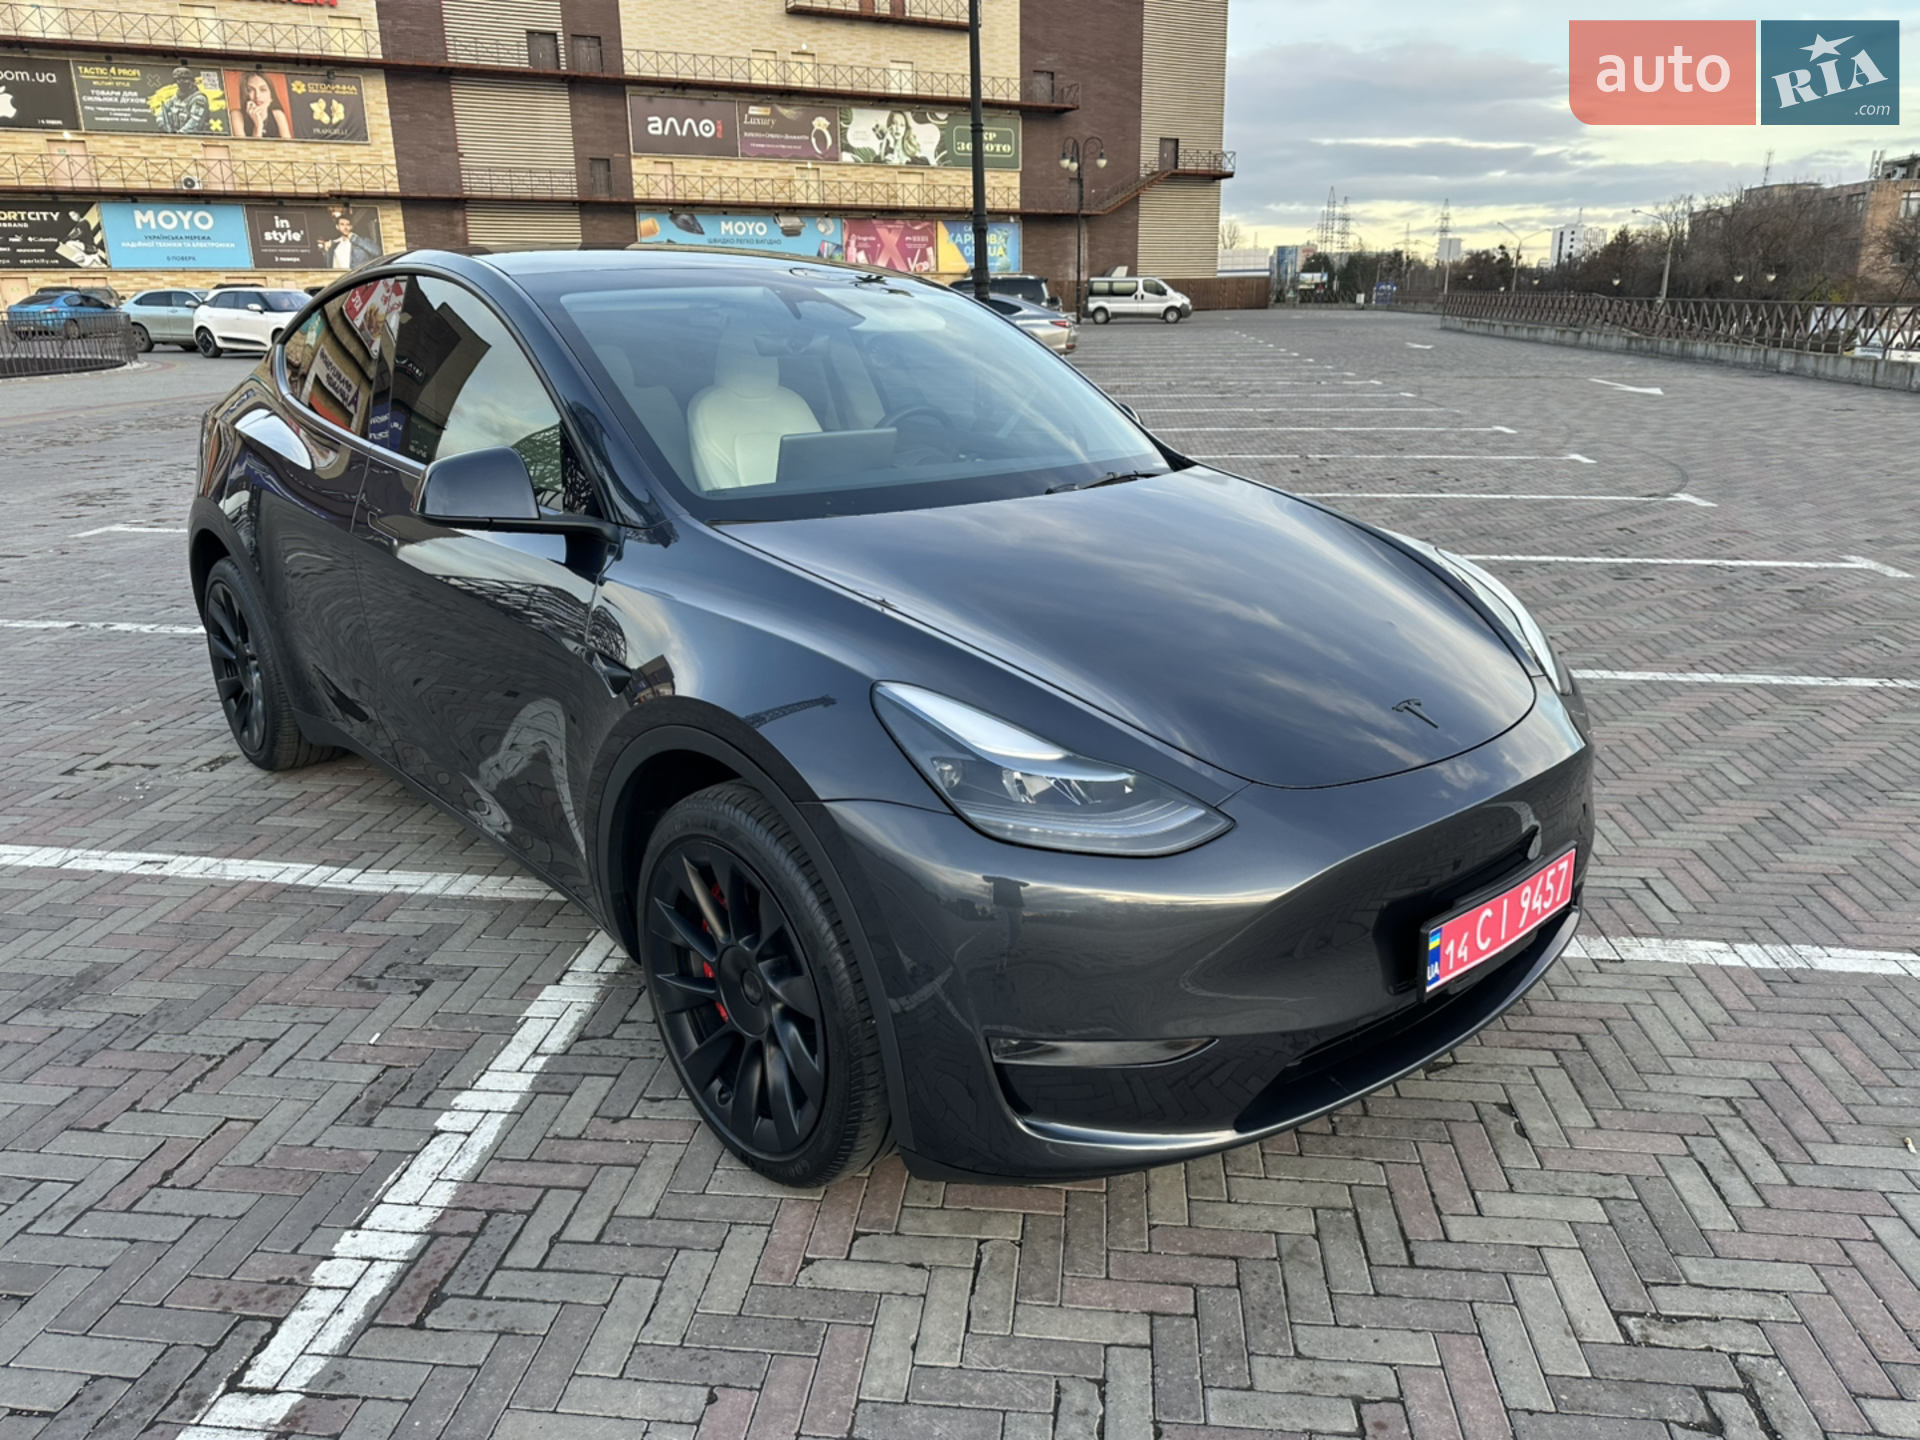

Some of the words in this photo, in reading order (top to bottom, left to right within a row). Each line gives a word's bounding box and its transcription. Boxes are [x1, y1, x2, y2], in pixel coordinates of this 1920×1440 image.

[743, 114, 777, 129] Luxury
[956, 142, 1012, 154] ЗООТО
[133, 210, 214, 230] MOYO
[274, 215, 290, 228] in
[721, 221, 768, 236] MOYO
[1445, 932, 1468, 970] 14
[1518, 860, 1569, 928] 9457
[1427, 961, 1441, 981] UA
